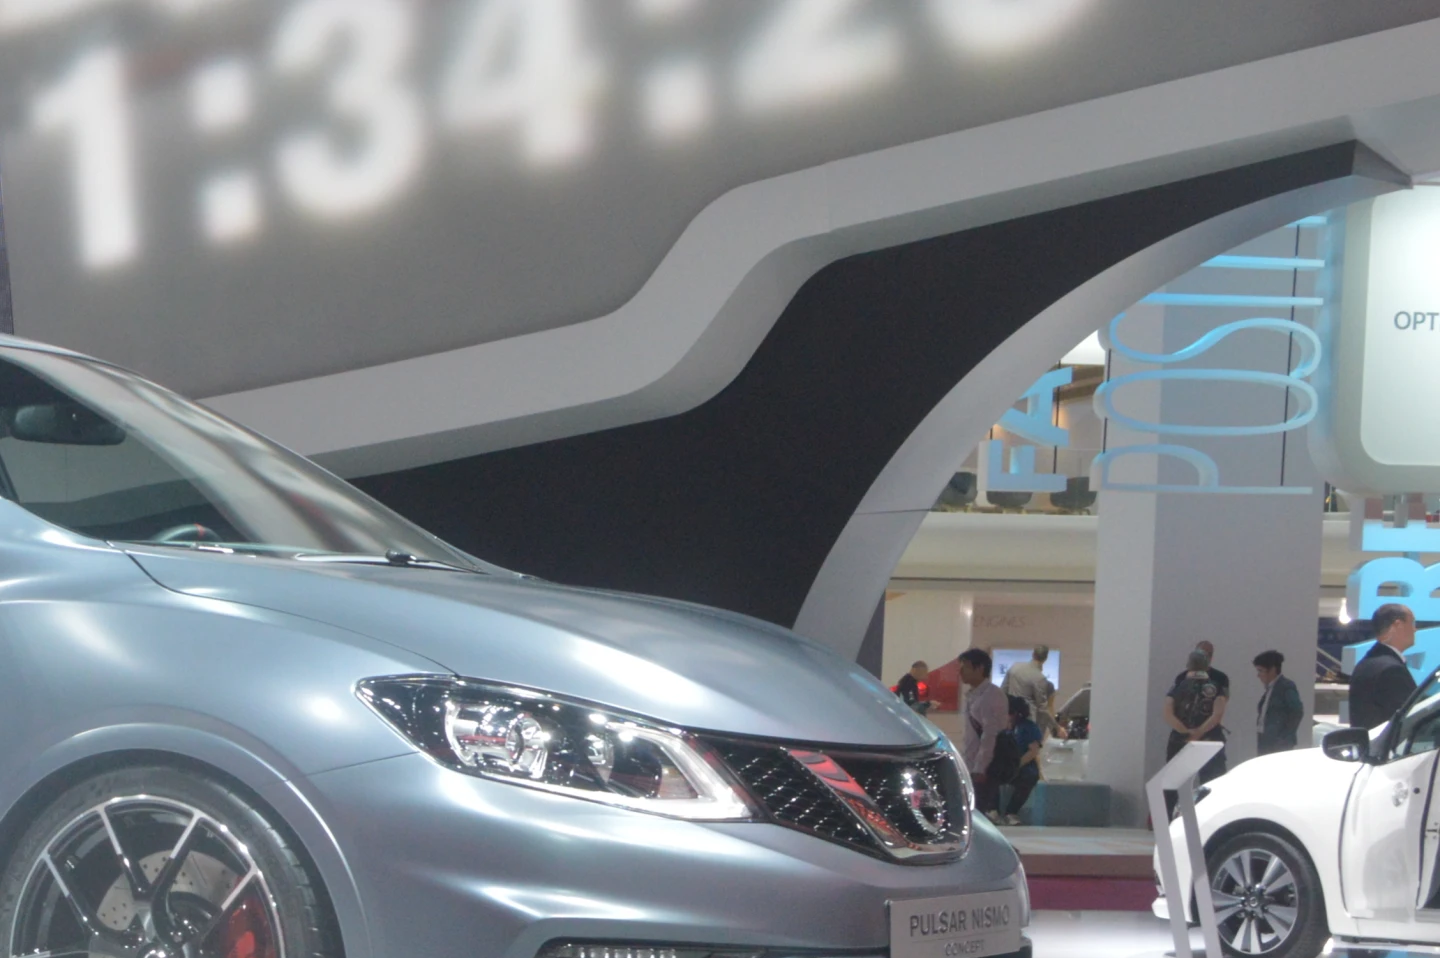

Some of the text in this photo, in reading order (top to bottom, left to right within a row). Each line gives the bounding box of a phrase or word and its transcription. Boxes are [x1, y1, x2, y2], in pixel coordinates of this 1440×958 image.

[909, 904, 1010, 937] PULSAR NISMO
[944, 940, 985, 957] CONCEPT
